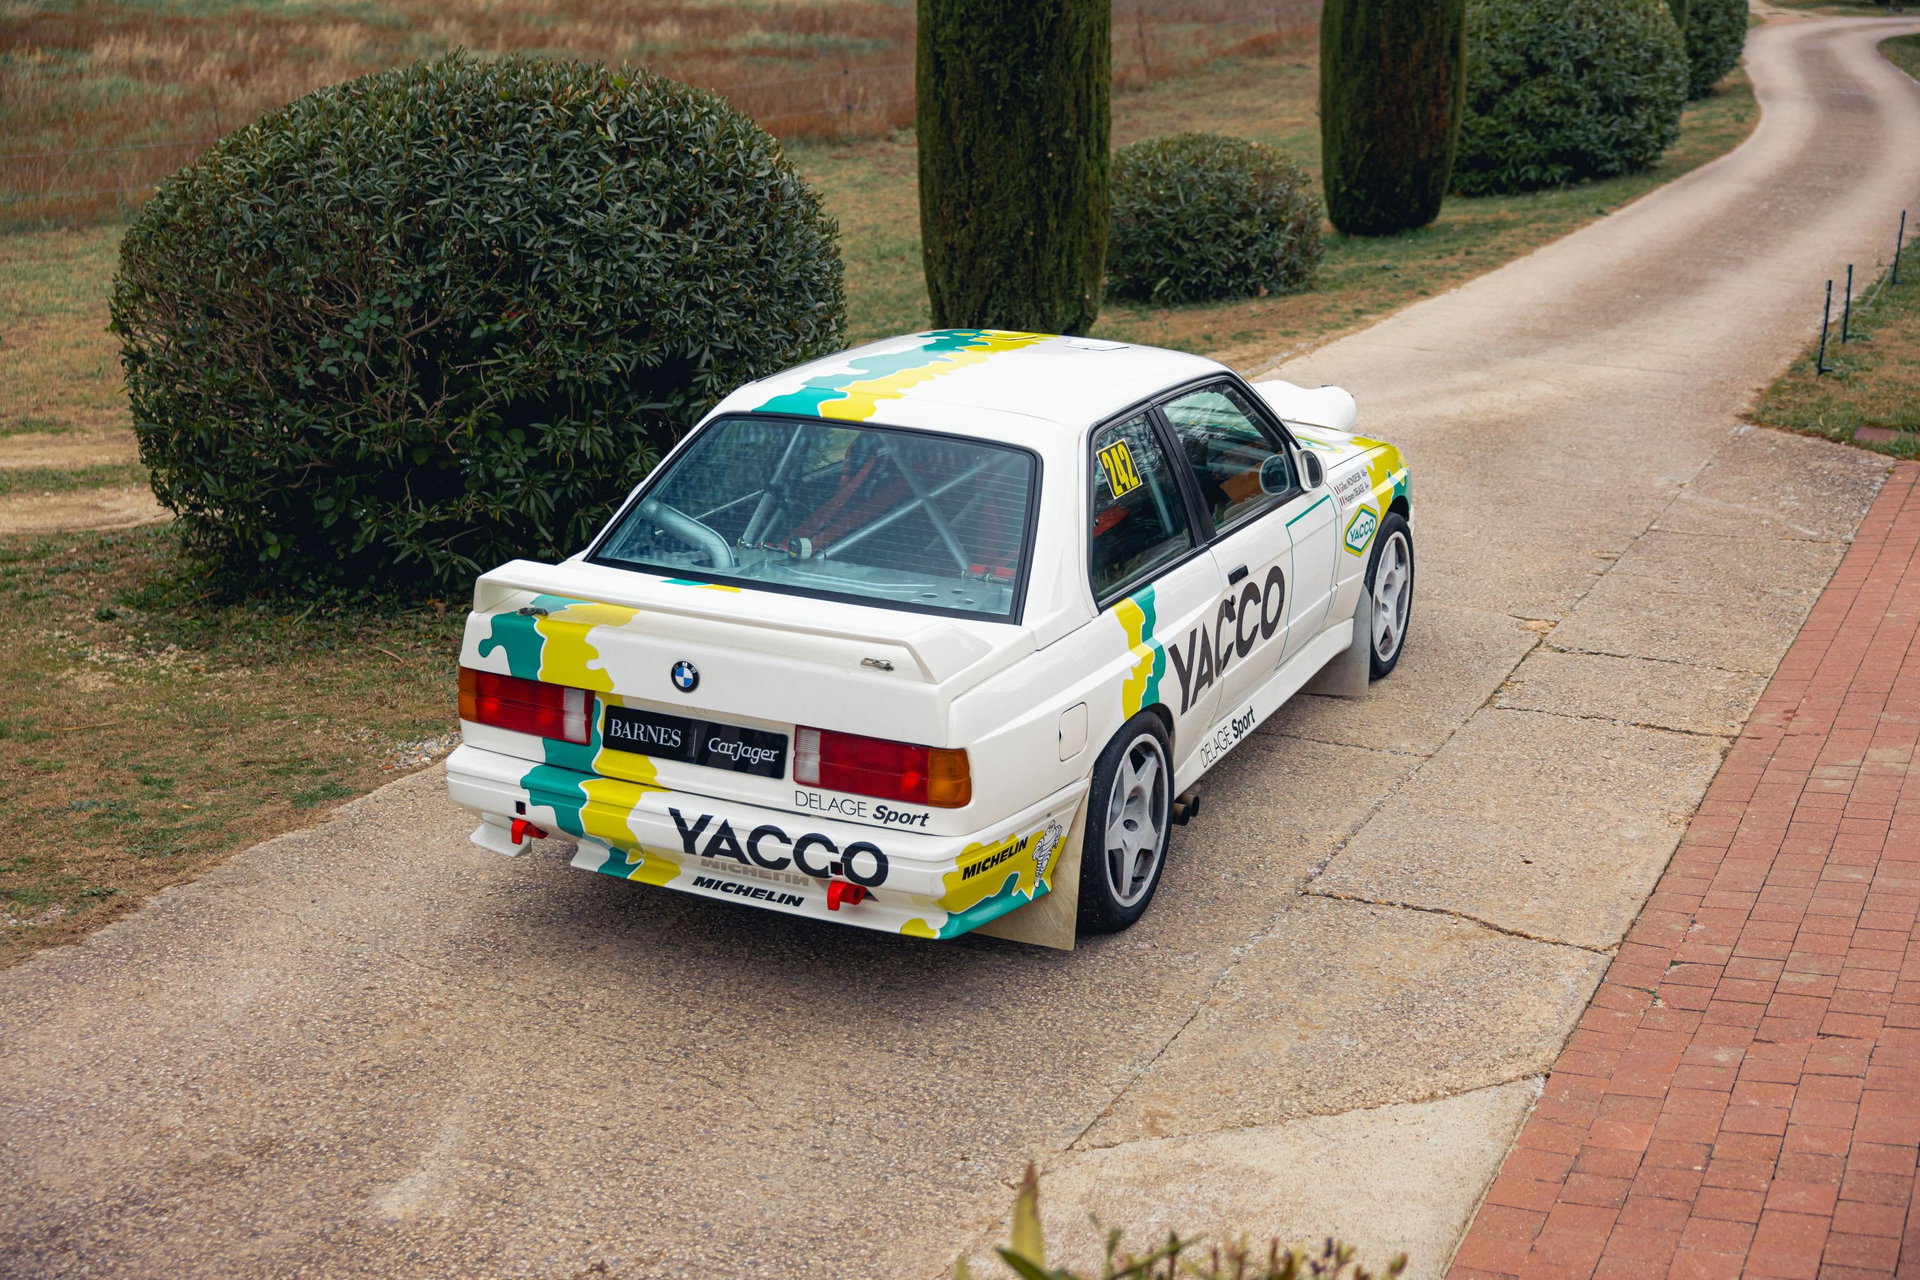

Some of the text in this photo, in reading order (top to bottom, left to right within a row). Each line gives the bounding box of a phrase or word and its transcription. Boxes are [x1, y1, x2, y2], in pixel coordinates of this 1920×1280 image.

[1101, 443, 1140, 496] 242
[1350, 518, 1374, 542] YACCO
[1168, 565, 1286, 716] YACCO
[673, 661, 698, 674] BMW
[609, 718, 780, 765] BARNES CarJager
[1200, 706, 1256, 769] DELAGE Sport
[795, 790, 930, 827] DELAGE Sport
[668, 806, 889, 888] YACCO
[962, 836, 1029, 881] MICHELIN
[692, 875, 805, 908] MICHELIN
